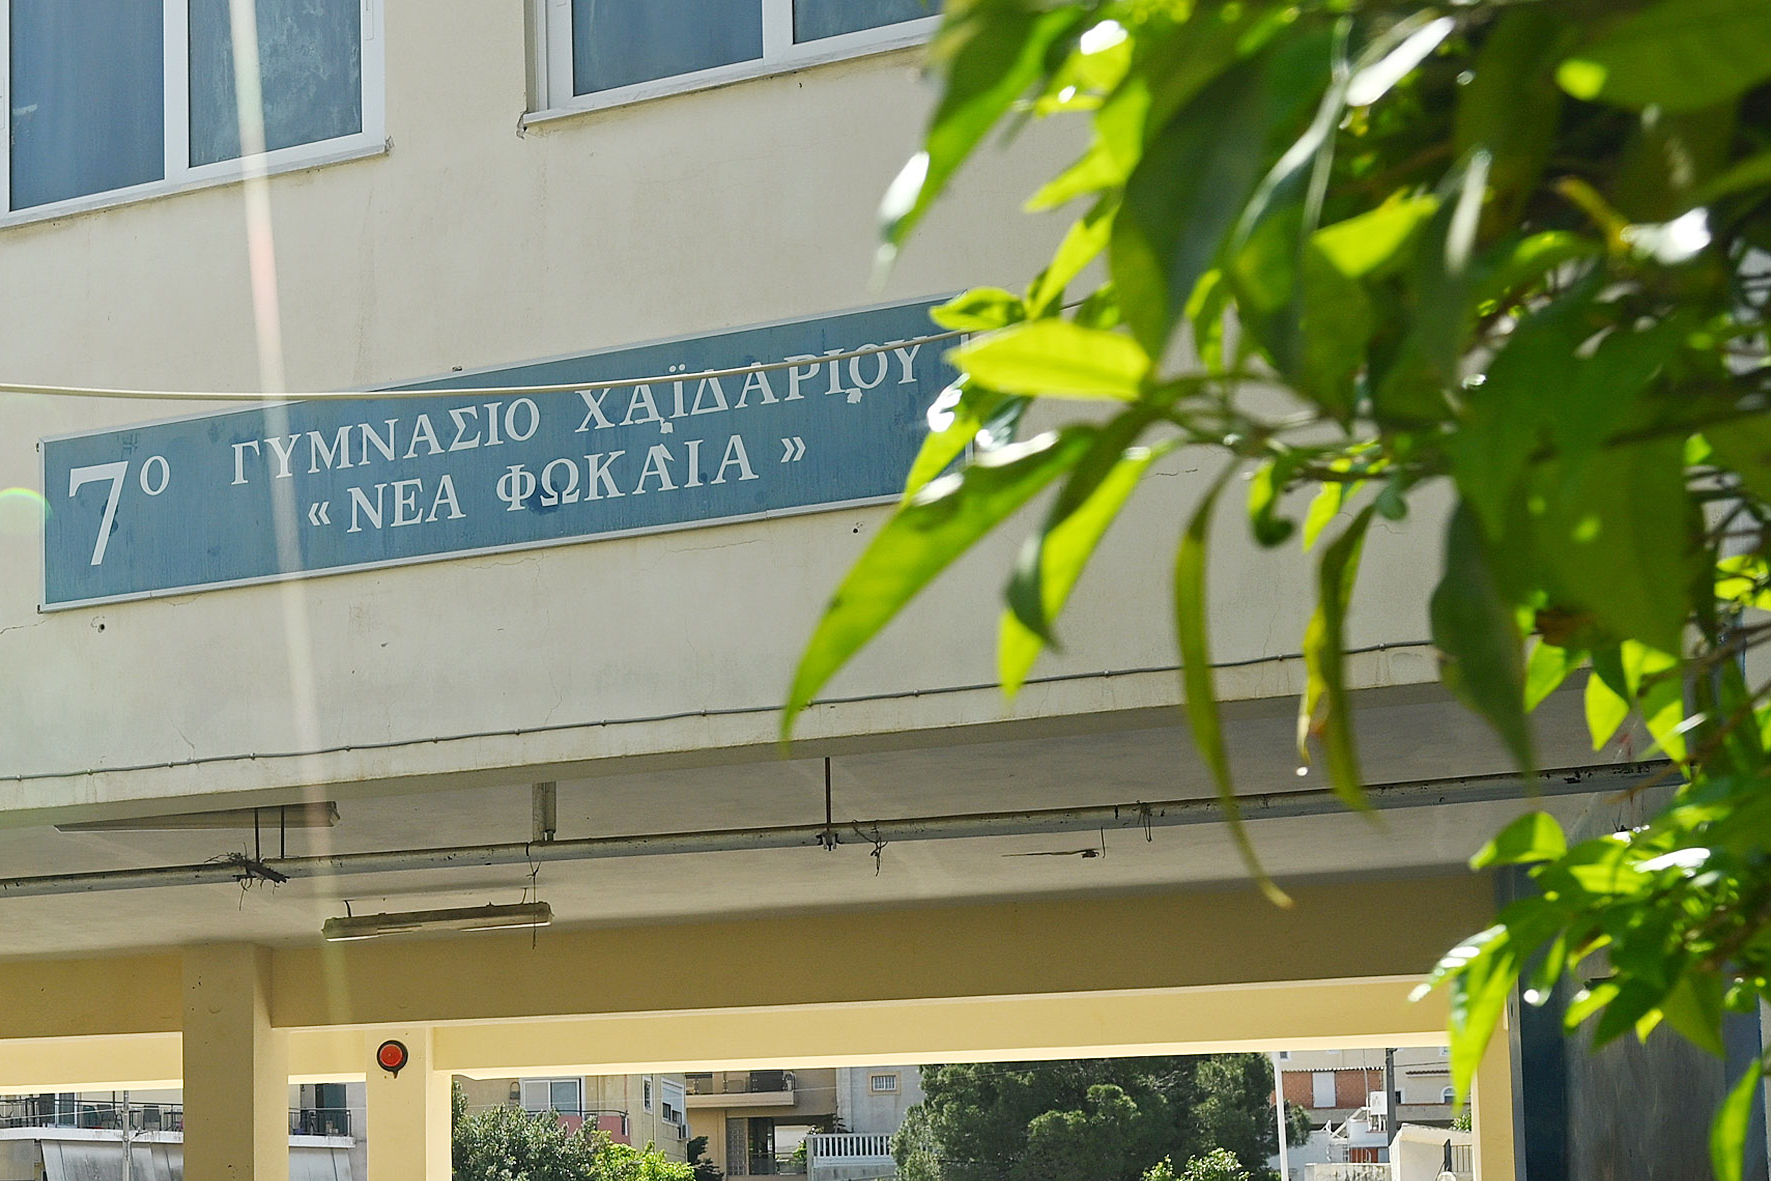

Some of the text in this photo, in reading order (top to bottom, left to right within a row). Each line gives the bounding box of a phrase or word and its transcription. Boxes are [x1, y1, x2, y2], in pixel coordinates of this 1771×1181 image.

[230, 397, 541, 486] ΓΥΜΝΑΣΙΟ
[574, 335, 929, 433] ΧΑΪΔΑΡΙΟΥ
[347, 474, 466, 533] ΝΕΑ
[495, 433, 760, 512] ΦΩΚΑΙΑ
